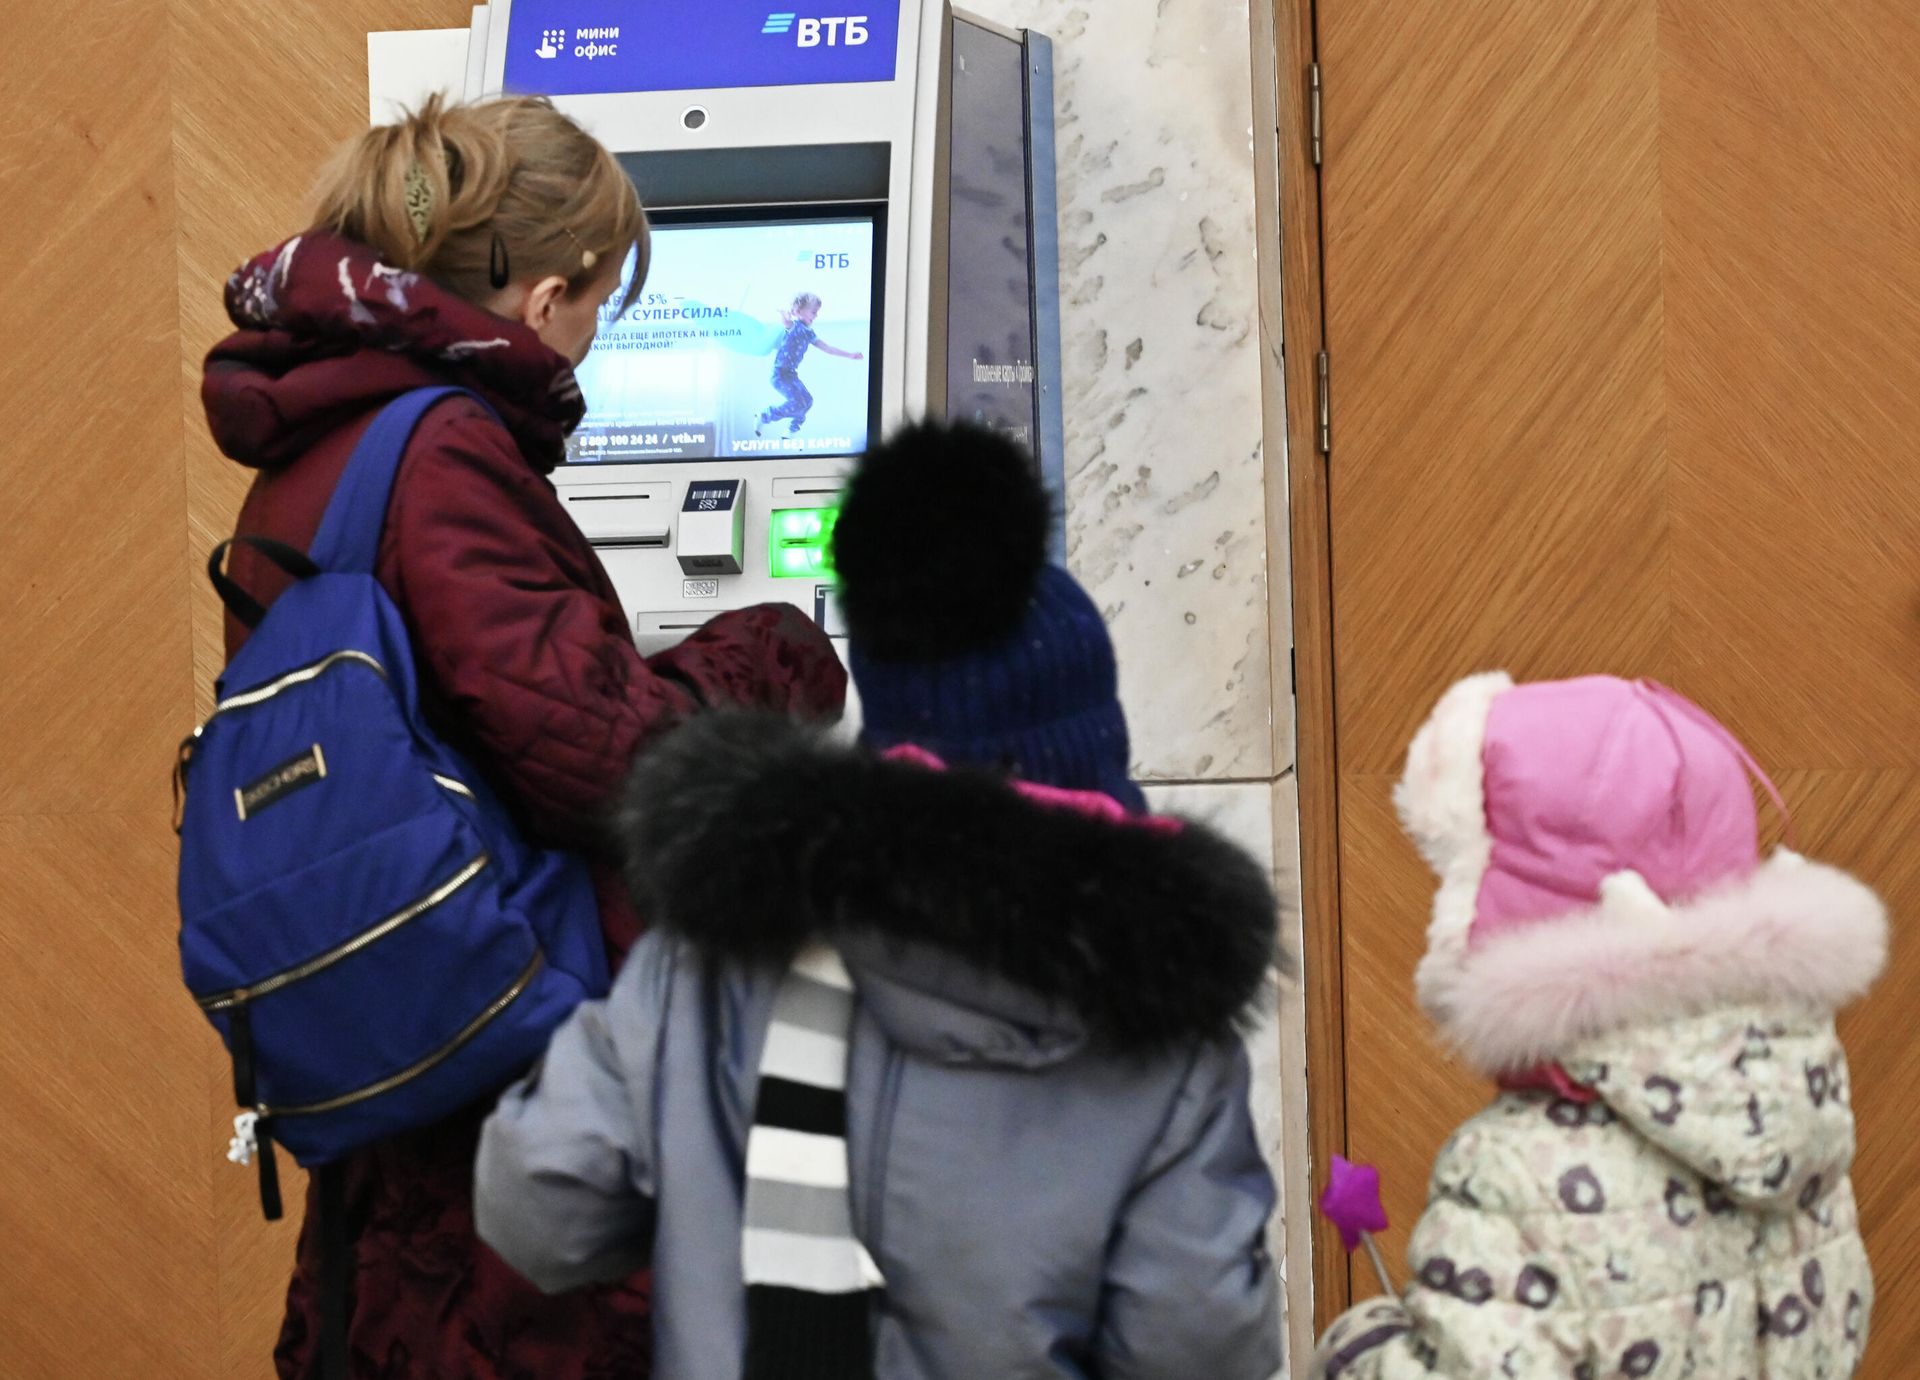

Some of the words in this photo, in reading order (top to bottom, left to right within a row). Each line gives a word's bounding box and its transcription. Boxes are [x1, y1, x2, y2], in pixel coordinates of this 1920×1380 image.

[797, 16, 869, 47] ВТБ
[574, 41, 617, 60] офис
[815, 253, 849, 269] ВТБ
[648, 293, 667, 306] 5%
[632, 307, 728, 321] СУПЕРСИЛА!
[652, 329, 696, 339] ИПОТЕКА
[714, 328, 742, 337] БЫЛА
[616, 340, 673, 350] ВЫГОДНОЙ!
[732, 440, 780, 451] УСЛУГИ
[808, 437, 851, 449] КАРТЫ
